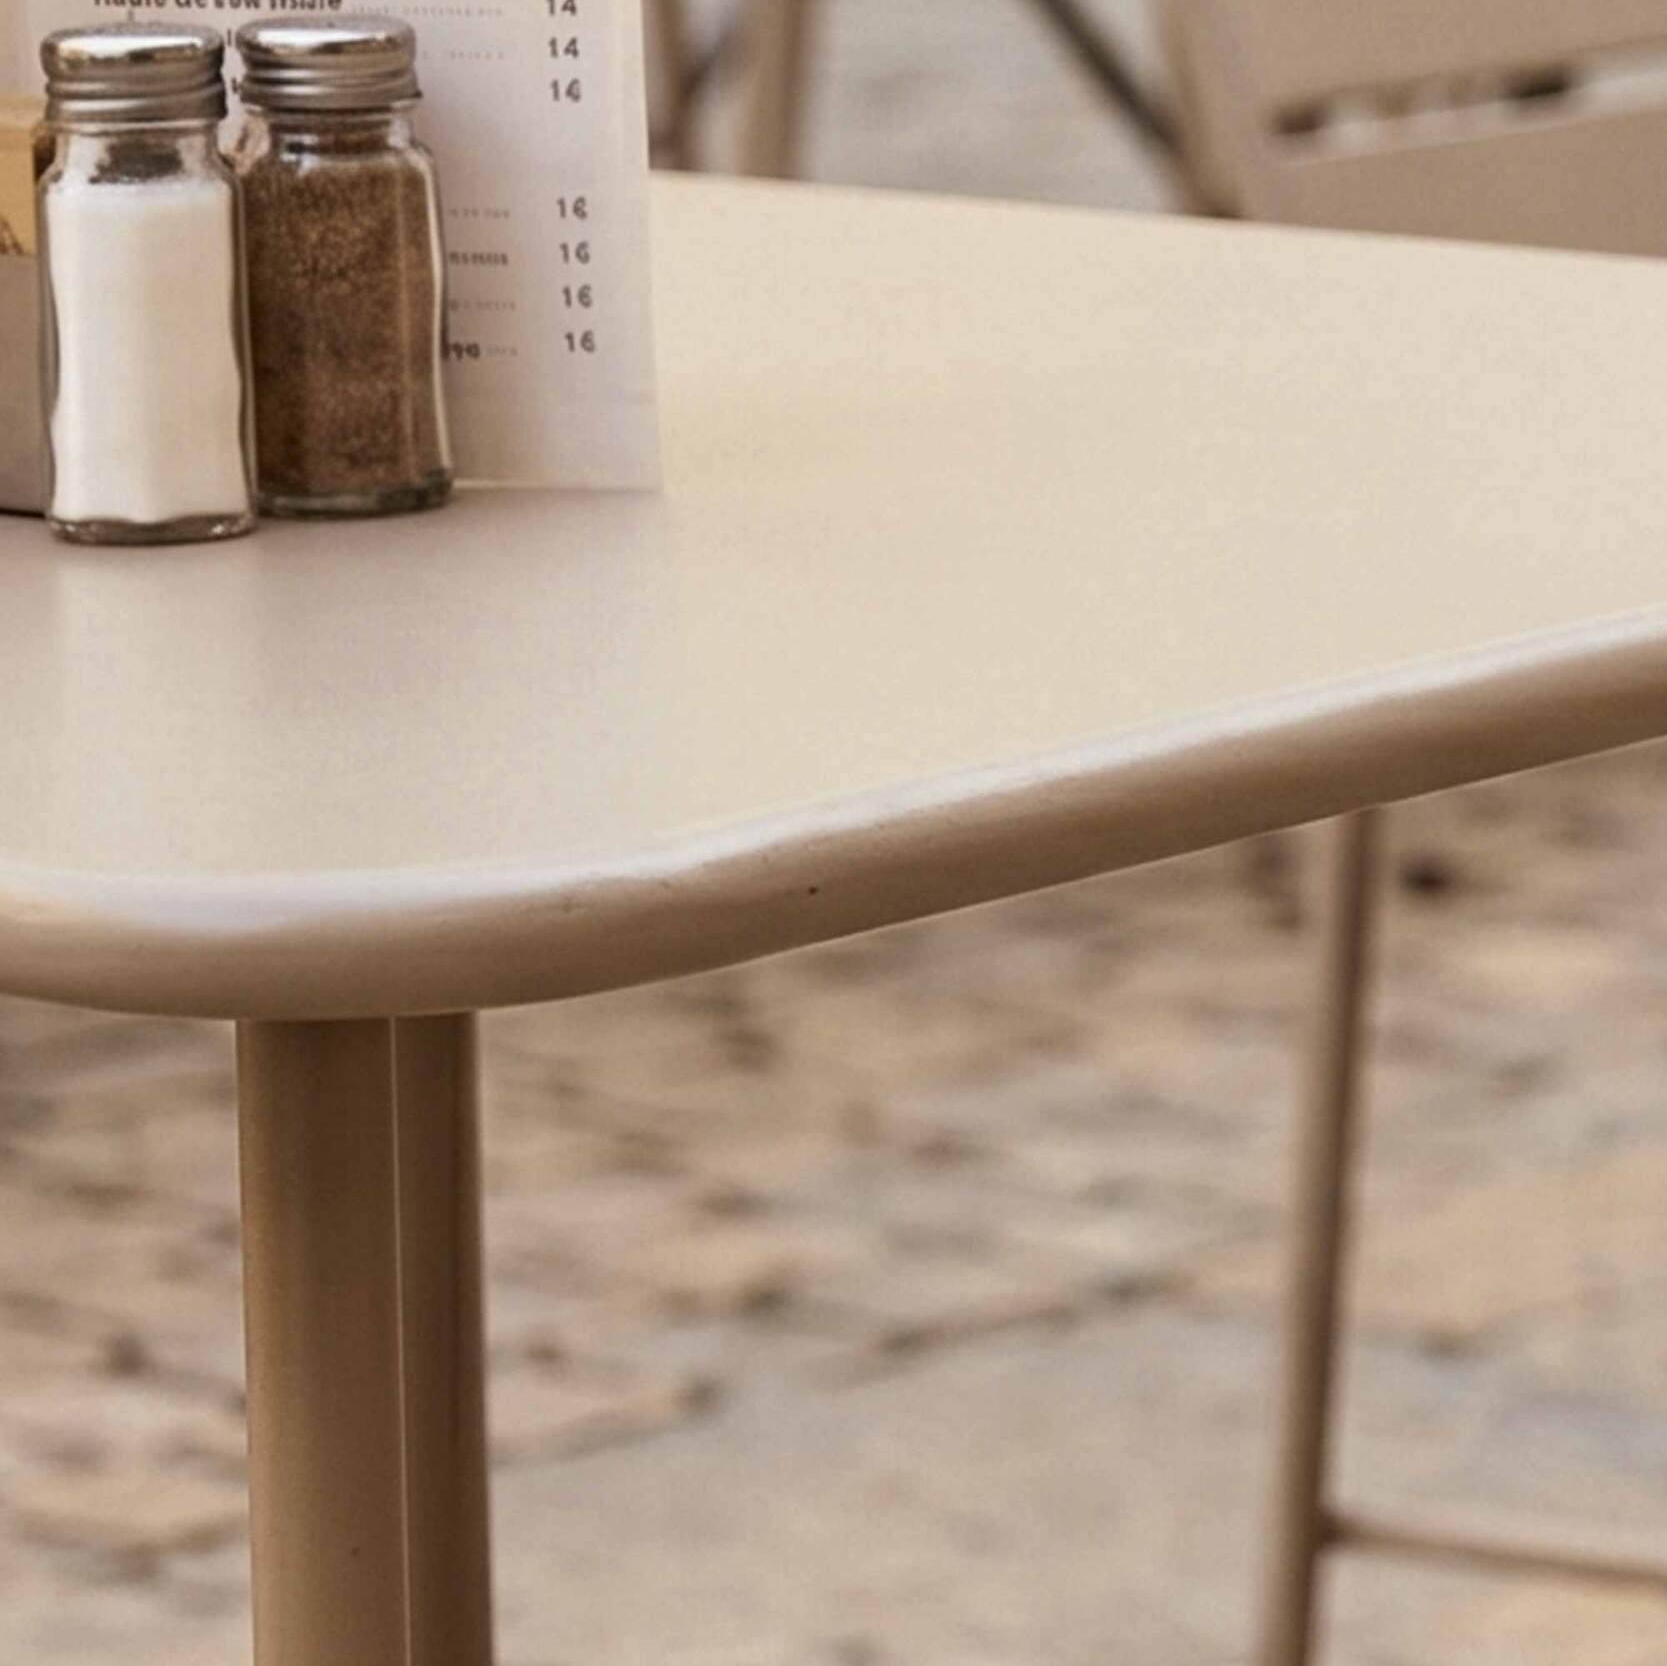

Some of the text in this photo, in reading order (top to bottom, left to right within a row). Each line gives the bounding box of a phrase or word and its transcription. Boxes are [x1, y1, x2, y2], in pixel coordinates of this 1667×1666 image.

[548, 36, 580, 59] 14
[556, 196, 588, 221] 16
[559, 240, 591, 265] 16
[562, 284, 592, 309] 16
[564, 330, 596, 353] 16
